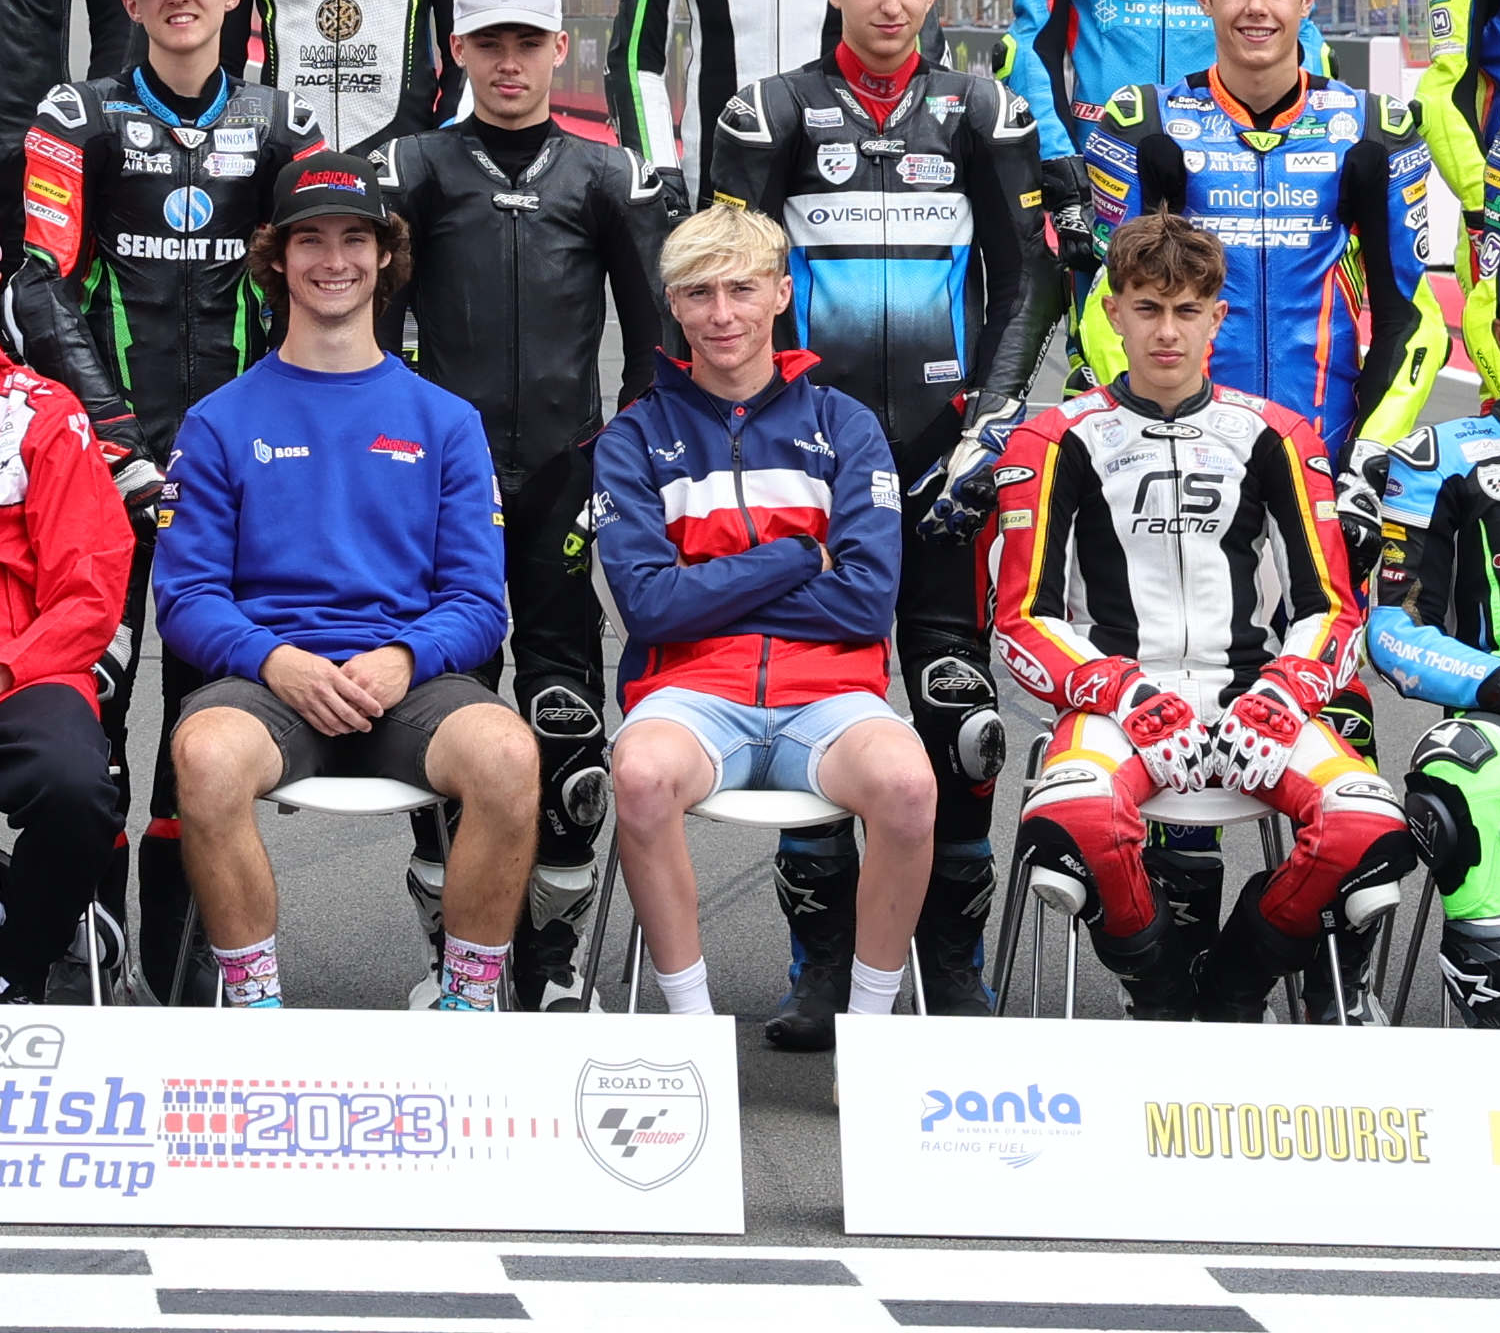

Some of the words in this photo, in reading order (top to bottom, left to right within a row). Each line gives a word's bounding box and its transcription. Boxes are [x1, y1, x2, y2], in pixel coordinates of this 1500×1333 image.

[123, 162, 143, 172] AIR
[147, 163, 172, 174] BAG
[1207, 182, 1319, 209] microlise
[832, 206, 957, 221] VISIONTRACK
[275, 446, 309, 458] BOSS
[1132, 518, 1220, 534] racing
[1378, 633, 1423, 662] FRANK
[1425, 652, 1486, 680] THOMAS
[597, 1075, 649, 1091] ROAD
[655, 1076, 685, 1091] TO
[921, 1084, 1082, 1133] panta
[238, 1090, 451, 1158] 2023
[957, 1127, 997, 1135] MEMBER
[1145, 1102, 1430, 1164] MOTOCOURSE
[921, 1140, 982, 1154] RACING
[988, 1141, 1029, 1155] FUEL
[59, 1152, 155, 1197] Cup
